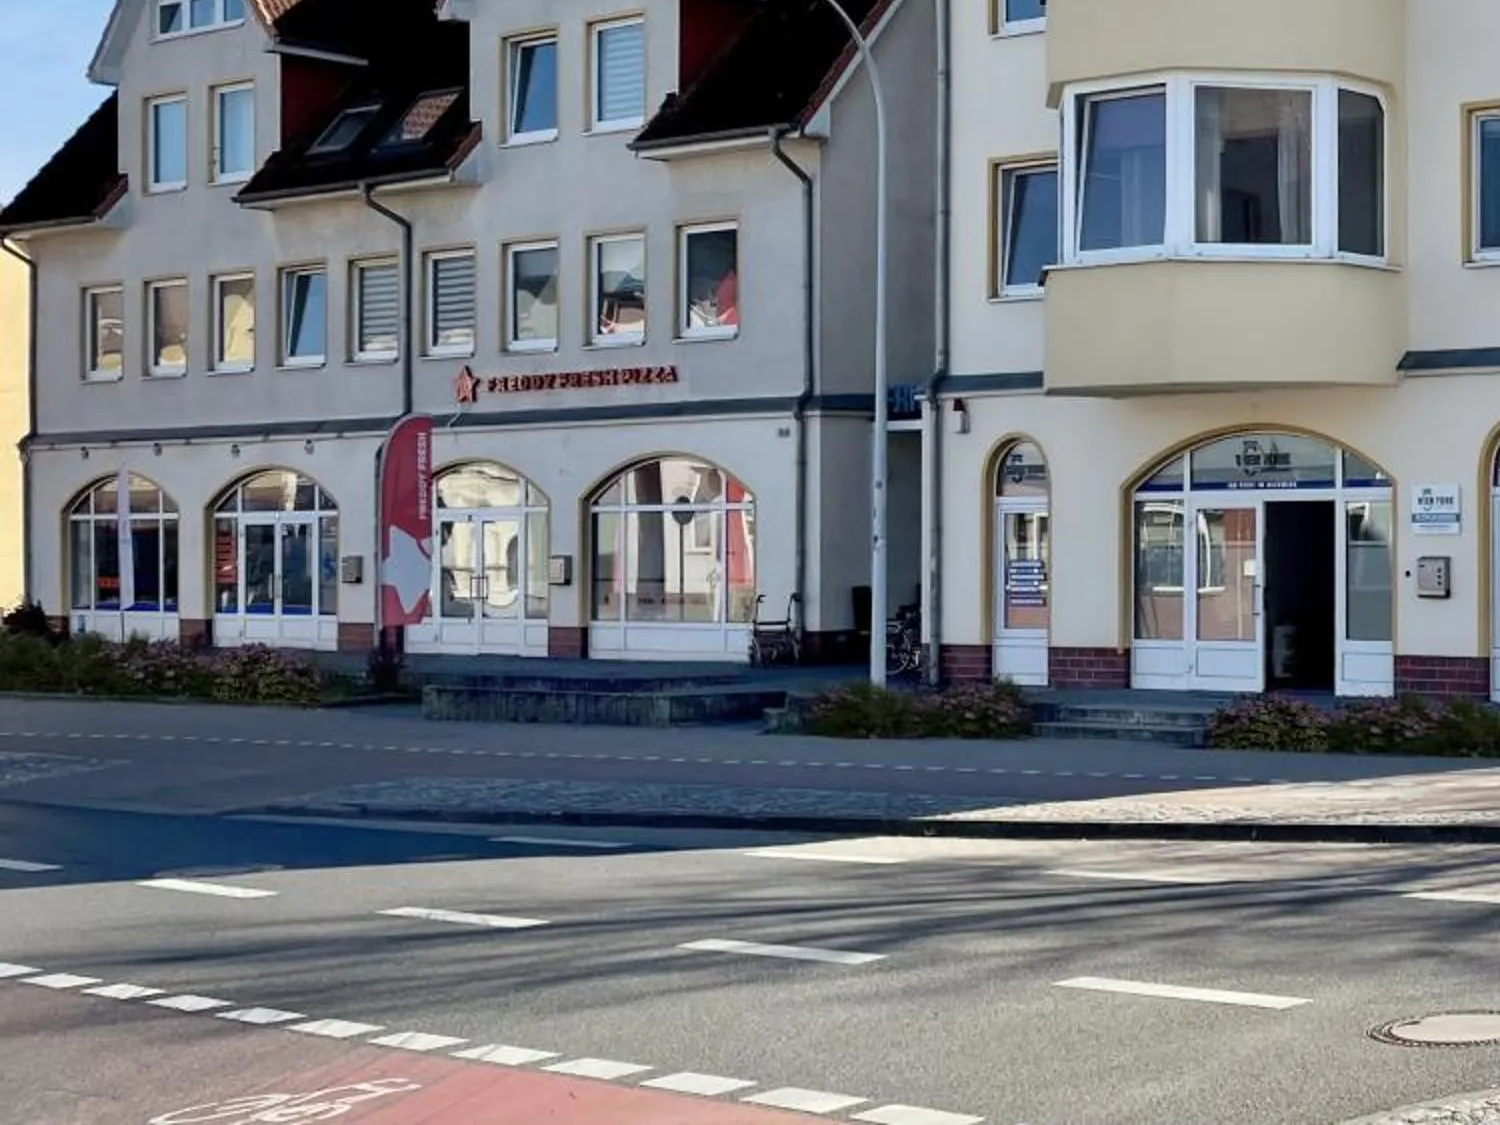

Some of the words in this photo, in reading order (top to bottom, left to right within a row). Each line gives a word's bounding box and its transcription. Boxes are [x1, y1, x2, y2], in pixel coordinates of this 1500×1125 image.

[487, 373, 557, 393] FREDDY
[559, 369, 619, 388] FRESH
[621, 364, 679, 383] PIZZA
